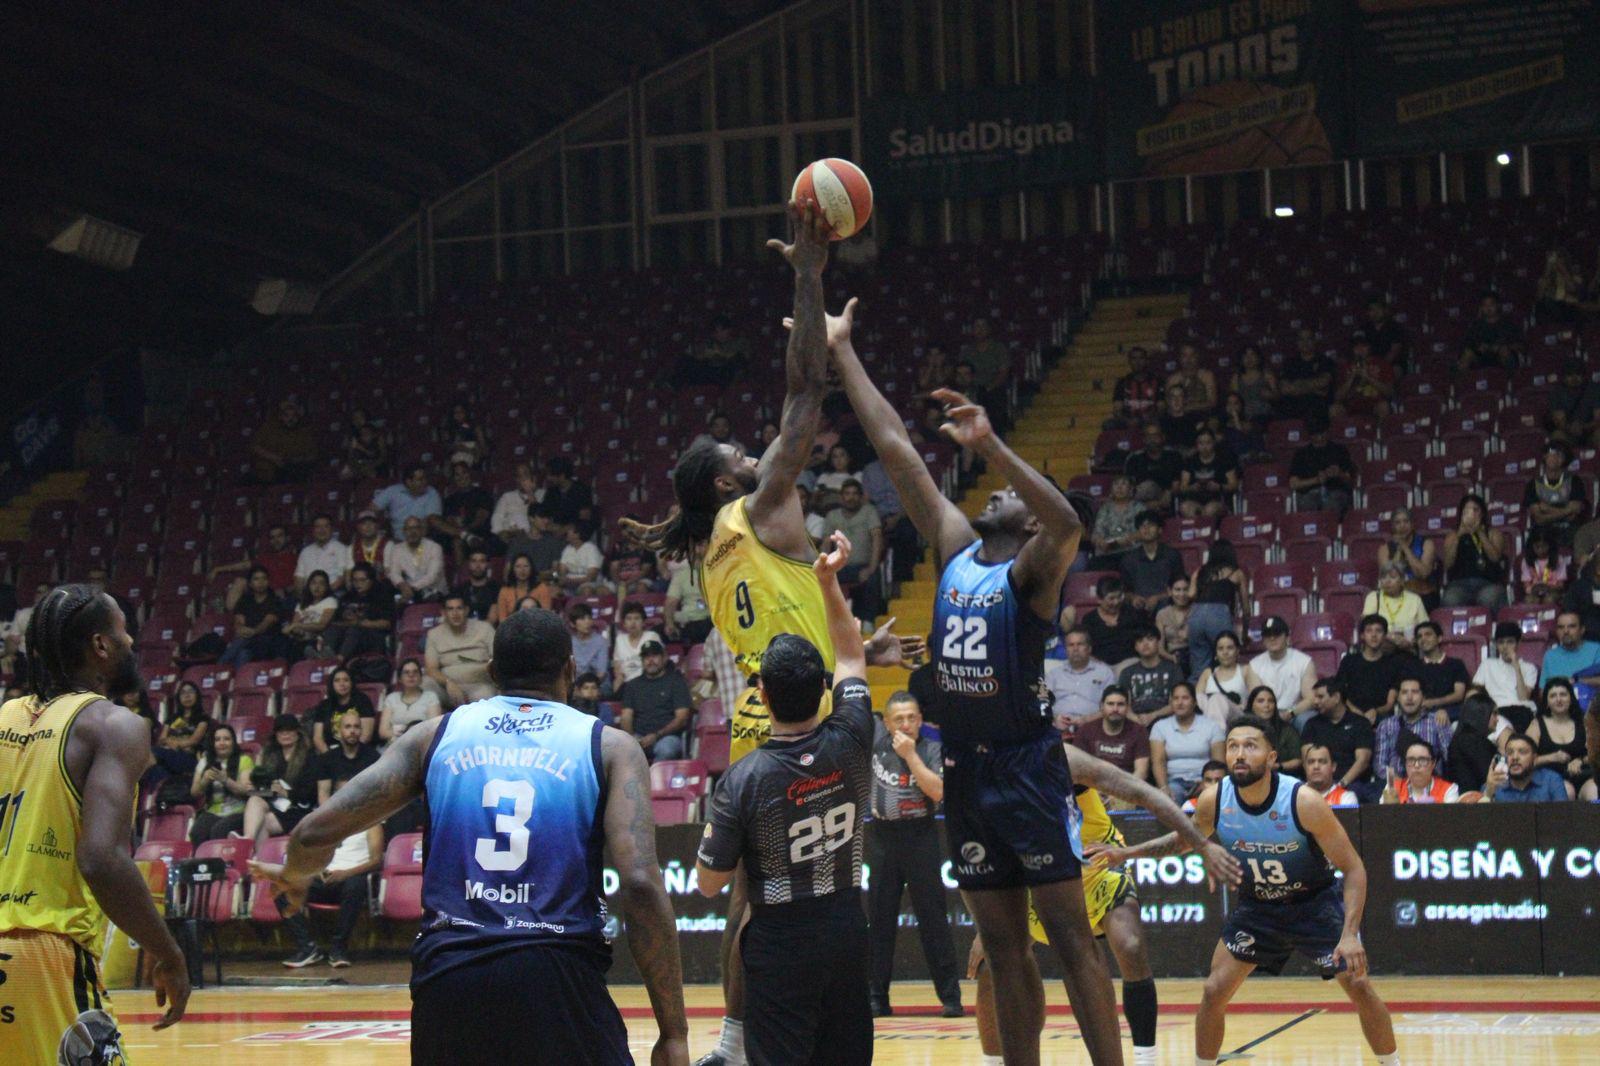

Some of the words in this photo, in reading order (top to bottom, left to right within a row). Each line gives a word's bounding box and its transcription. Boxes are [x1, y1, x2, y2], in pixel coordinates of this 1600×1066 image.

[888, 118, 1074, 159] SaludDigna
[735, 581, 755, 629] 9
[942, 615, 987, 660] 22
[938, 661, 950, 674] AL
[951, 664, 993, 678] ESTILO
[444, 745, 571, 781] THORNWELL
[475, 778, 535, 871] 3
[788, 802, 856, 864] 29
[1231, 839, 1299, 854] ASTROS
[1393, 841, 1523, 880] DISEÑA
[1530, 848, 1555, 879] Y
[1565, 847, 1600, 879] C
[1247, 858, 1288, 885] 13
[465, 879, 530, 904] Mobil
